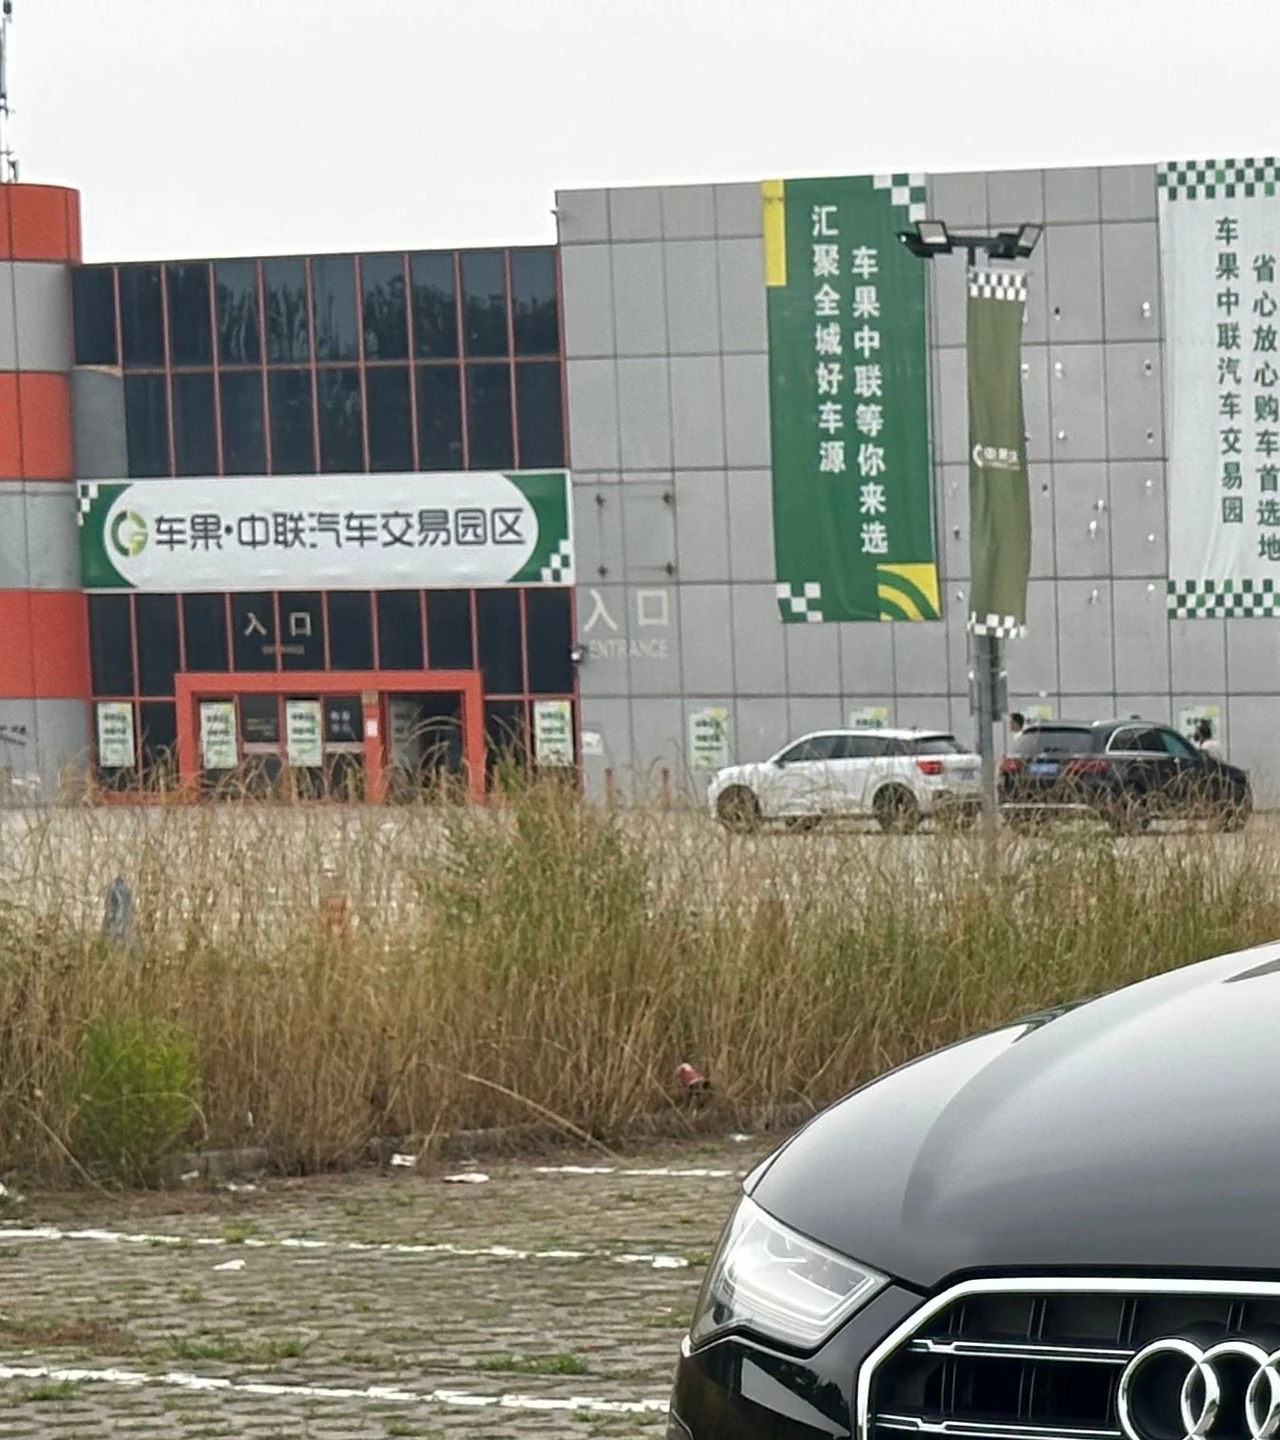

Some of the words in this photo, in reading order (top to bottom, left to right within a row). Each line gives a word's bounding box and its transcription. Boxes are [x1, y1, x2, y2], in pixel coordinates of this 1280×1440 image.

[811, 204, 846, 474] 汇聚全城好车源
[1215, 216, 1244, 524] 车果中联汽车交易园
[851, 245, 889, 555] 车果中联等你来选
[154, 507, 526, 551] 车果·中联汽车交易园区
[244, 611, 312, 637] 入口
[583, 588, 669, 632] 入口
[589, 638, 669, 659] ENTRANCE
